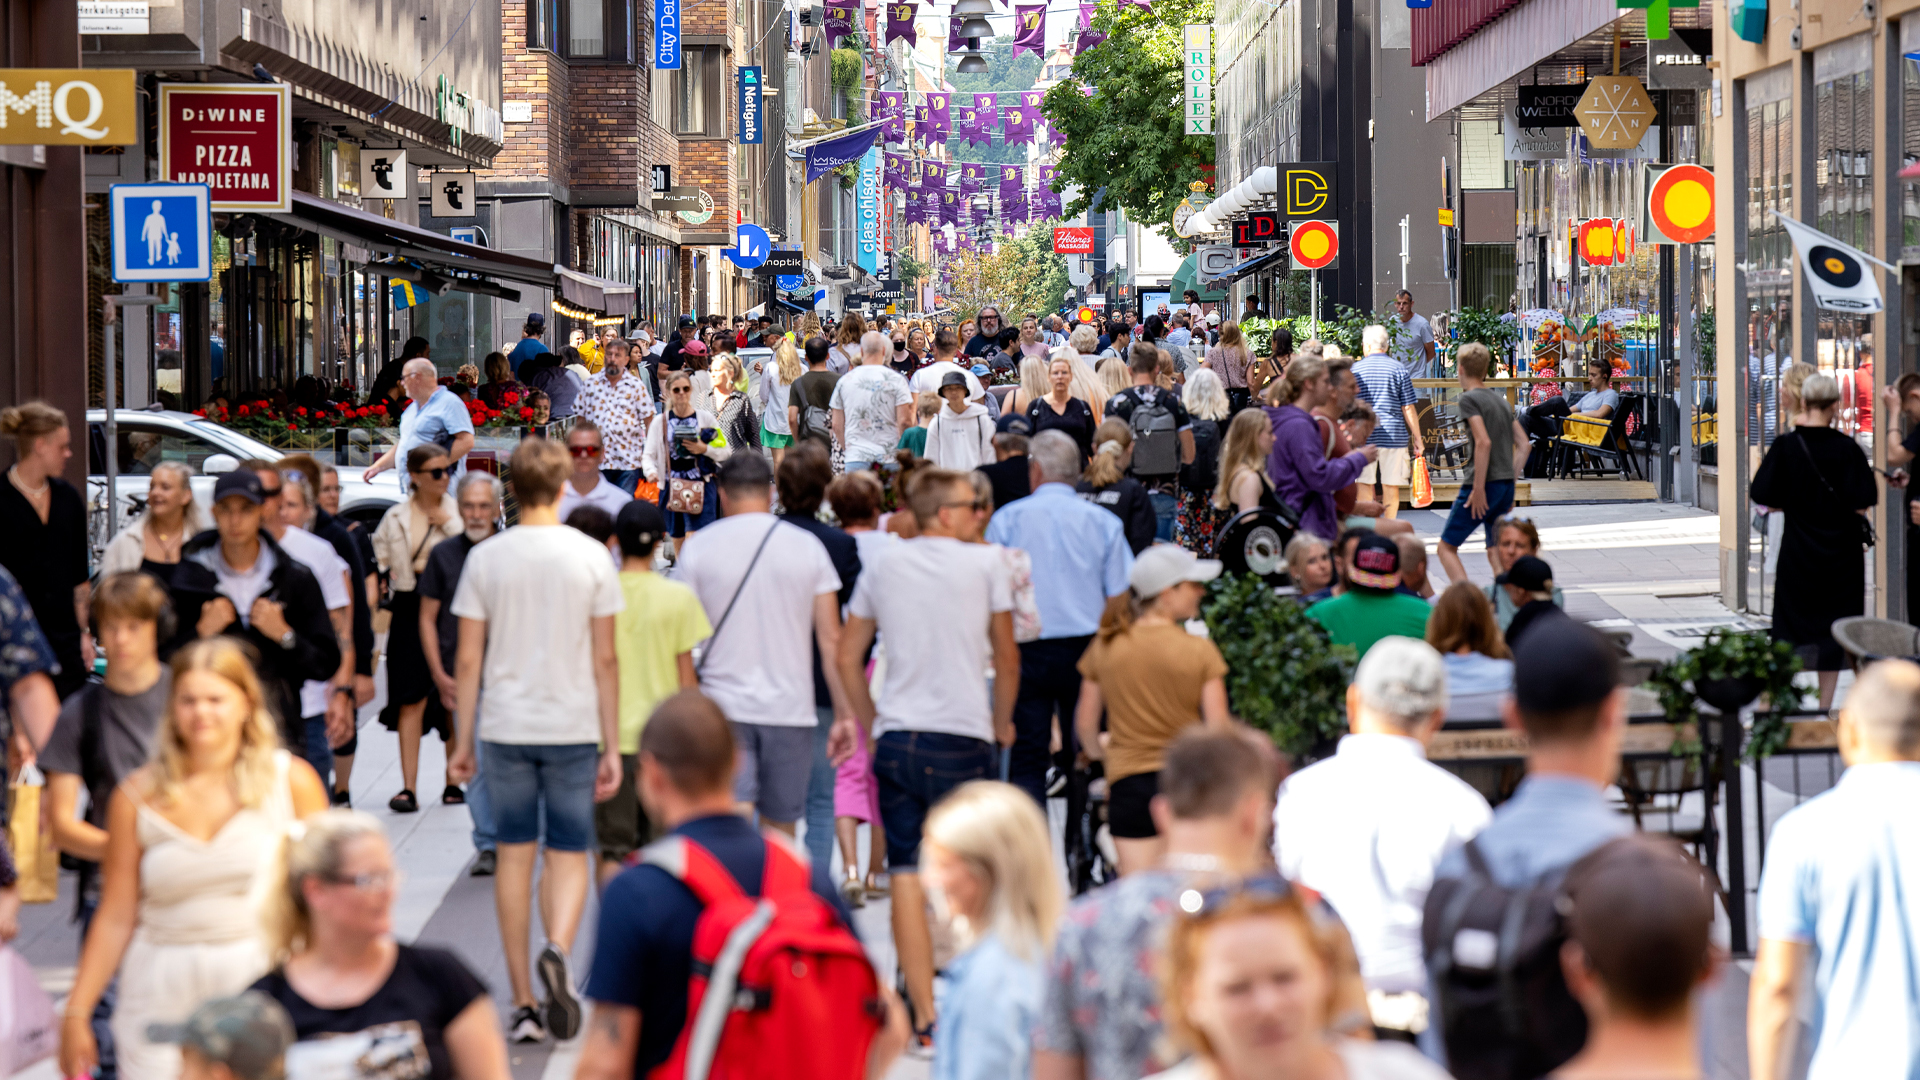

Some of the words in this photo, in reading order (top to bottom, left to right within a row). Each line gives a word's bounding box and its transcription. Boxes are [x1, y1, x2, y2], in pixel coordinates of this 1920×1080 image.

[78, 5, 146, 17] Herkulesgatan
[660, 30, 677, 65] City
[1656, 54, 1702, 66] PELLE
[1191, 51, 1205, 132] ROLEX
[1534, 95, 1580, 107] NORDI
[0, 80, 110, 140] MQ
[182, 107, 266, 123] DiWINE
[742, 86, 757, 140] Netigate
[1521, 106, 1575, 118] WELLN
[1510, 136, 1560, 155] Amandas
[196, 145, 252, 167] PIZZA
[177, 172, 270, 190] NAPOLETANA
[860, 168, 874, 219] ohlson
[860, 222, 874, 253] clas
